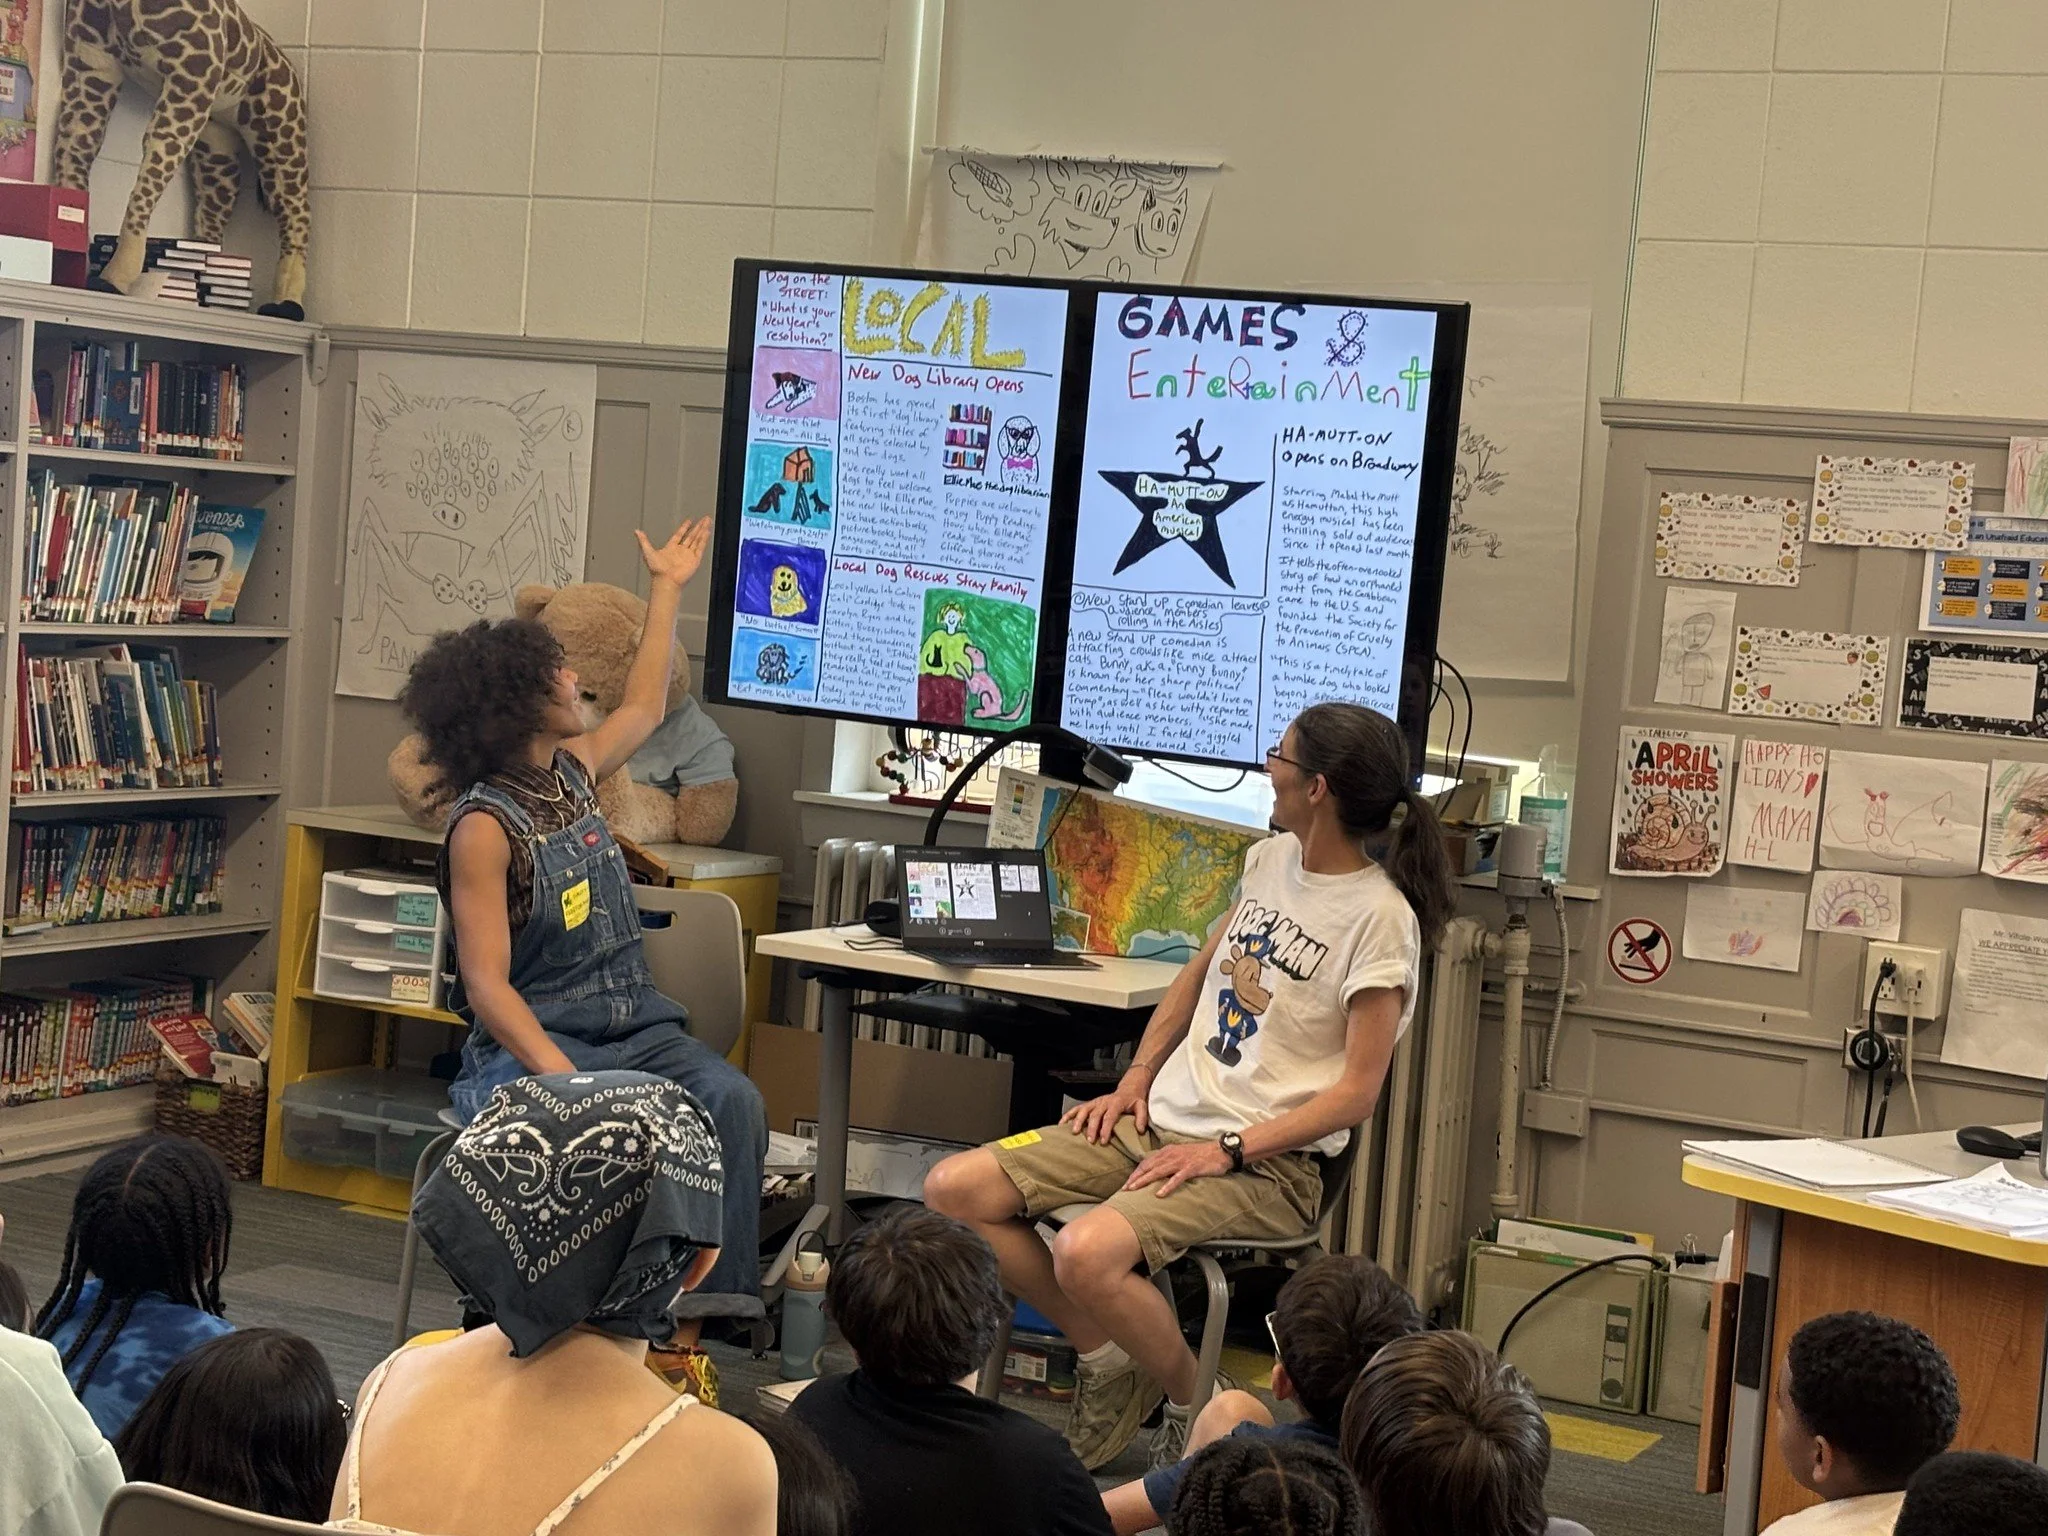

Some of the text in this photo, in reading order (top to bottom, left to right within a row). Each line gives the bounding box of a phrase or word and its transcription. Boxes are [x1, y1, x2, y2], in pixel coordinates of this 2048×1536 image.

[766, 271, 831, 288] Dog on the
[779, 286, 828, 301] STREET:
[800, 305, 809, 314] is
[812, 307, 836, 320] your
[762, 314, 820, 331] New Year's
[1118, 295, 1306, 351] GAMES
[766, 330, 834, 347] resolution?"
[847, 362, 1024, 394] New Dog Library Opens
[1282, 425, 1393, 446] HA-MUTT-ON
[1330, 458, 1348, 467] on
[1352, 450, 1419, 480] Broadway
[1138, 478, 1225, 499] HA-MUTT-ON
[1283, 485, 1327, 500] Starring
[1331, 489, 1358, 500] Mabel
[1361, 490, 1376, 501] the
[1171, 498, 1185, 510] An
[1351, 503, 1372, 515] this
[1377, 506, 1398, 520] high
[1155, 513, 1202, 526] American
[1282, 511, 1404, 532] energy musical has been
[1282, 524, 1327, 538] thrilling
[1333, 528, 1354, 540] sold
[1356, 531, 1372, 541] out
[1316, 539, 1325, 550] it
[1329, 541, 1363, 554] opened
[1365, 544, 1383, 556] last
[1278, 556, 1295, 566] It
[1297, 555, 1316, 569] tells
[1316, 559, 1332, 571] the
[834, 557, 1028, 602] Local Dog Rescues Stray Family
[1307, 573, 1320, 582] of
[1324, 574, 1340, 584] how
[1344, 579, 1358, 587] an
[1360, 579, 1403, 592] orphaned
[1280, 585, 1305, 593] mutt
[1311, 585, 1333, 597] from
[1339, 587, 1353, 597] the
[1107, 604, 1208, 619] audience members
[1231, 597, 1260, 611] leaves
[1277, 596, 1303, 605] came
[1310, 597, 1319, 607] to
[1324, 599, 1339, 610] the
[1364, 604, 1384, 615] and
[1117, 615, 1149, 629] rolling
[1153, 618, 1162, 627] in
[1166, 616, 1186, 629] the
[1278, 606, 1398, 632] founded the Society for
[1078, 631, 1102, 641] new
[1161, 637, 1211, 648] comedian
[1217, 636, 1228, 648] is
[1275, 622, 1393, 649] the Prevention of Cruelty
[1275, 634, 1286, 646] to
[1068, 642, 1124, 658] attracting
[1129, 647, 1161, 657] crowds
[1191, 652, 1216, 662] mice
[1221, 651, 1257, 664] attract
[1068, 653, 1092, 665] cats
[1068, 667, 1241, 691] is known for her sharp political
[1744, 740, 1825, 768] HAPPY HO
[1630, 770, 1719, 792] SHOWERS
[1743, 767, 1804, 794] LIDAYS
[1750, 801, 1812, 842] MAYA
[1744, 836, 1779, 862] H-L
[1228, 900, 1330, 981] DOG MAN
[1978, 939, 2041, 954] WE APPRECIATE
